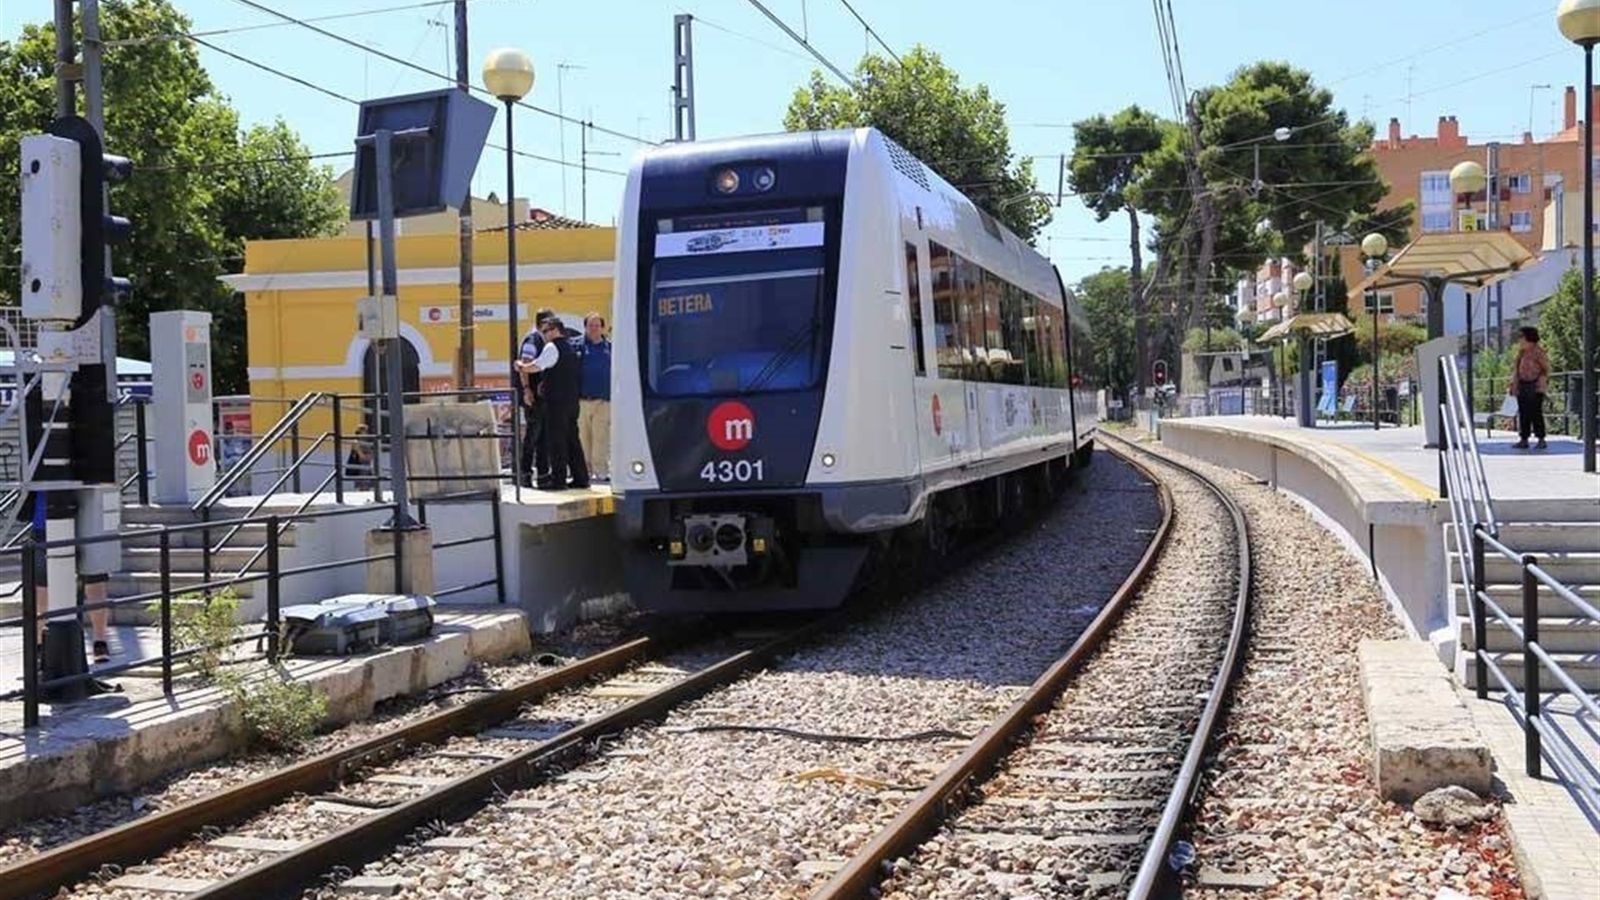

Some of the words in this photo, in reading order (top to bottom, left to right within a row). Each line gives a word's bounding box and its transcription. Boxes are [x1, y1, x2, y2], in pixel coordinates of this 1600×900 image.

[658, 293, 713, 316] BETERA
[725, 418, 752, 440] m
[197, 443, 210, 459] m
[700, 460, 763, 482] 4301
